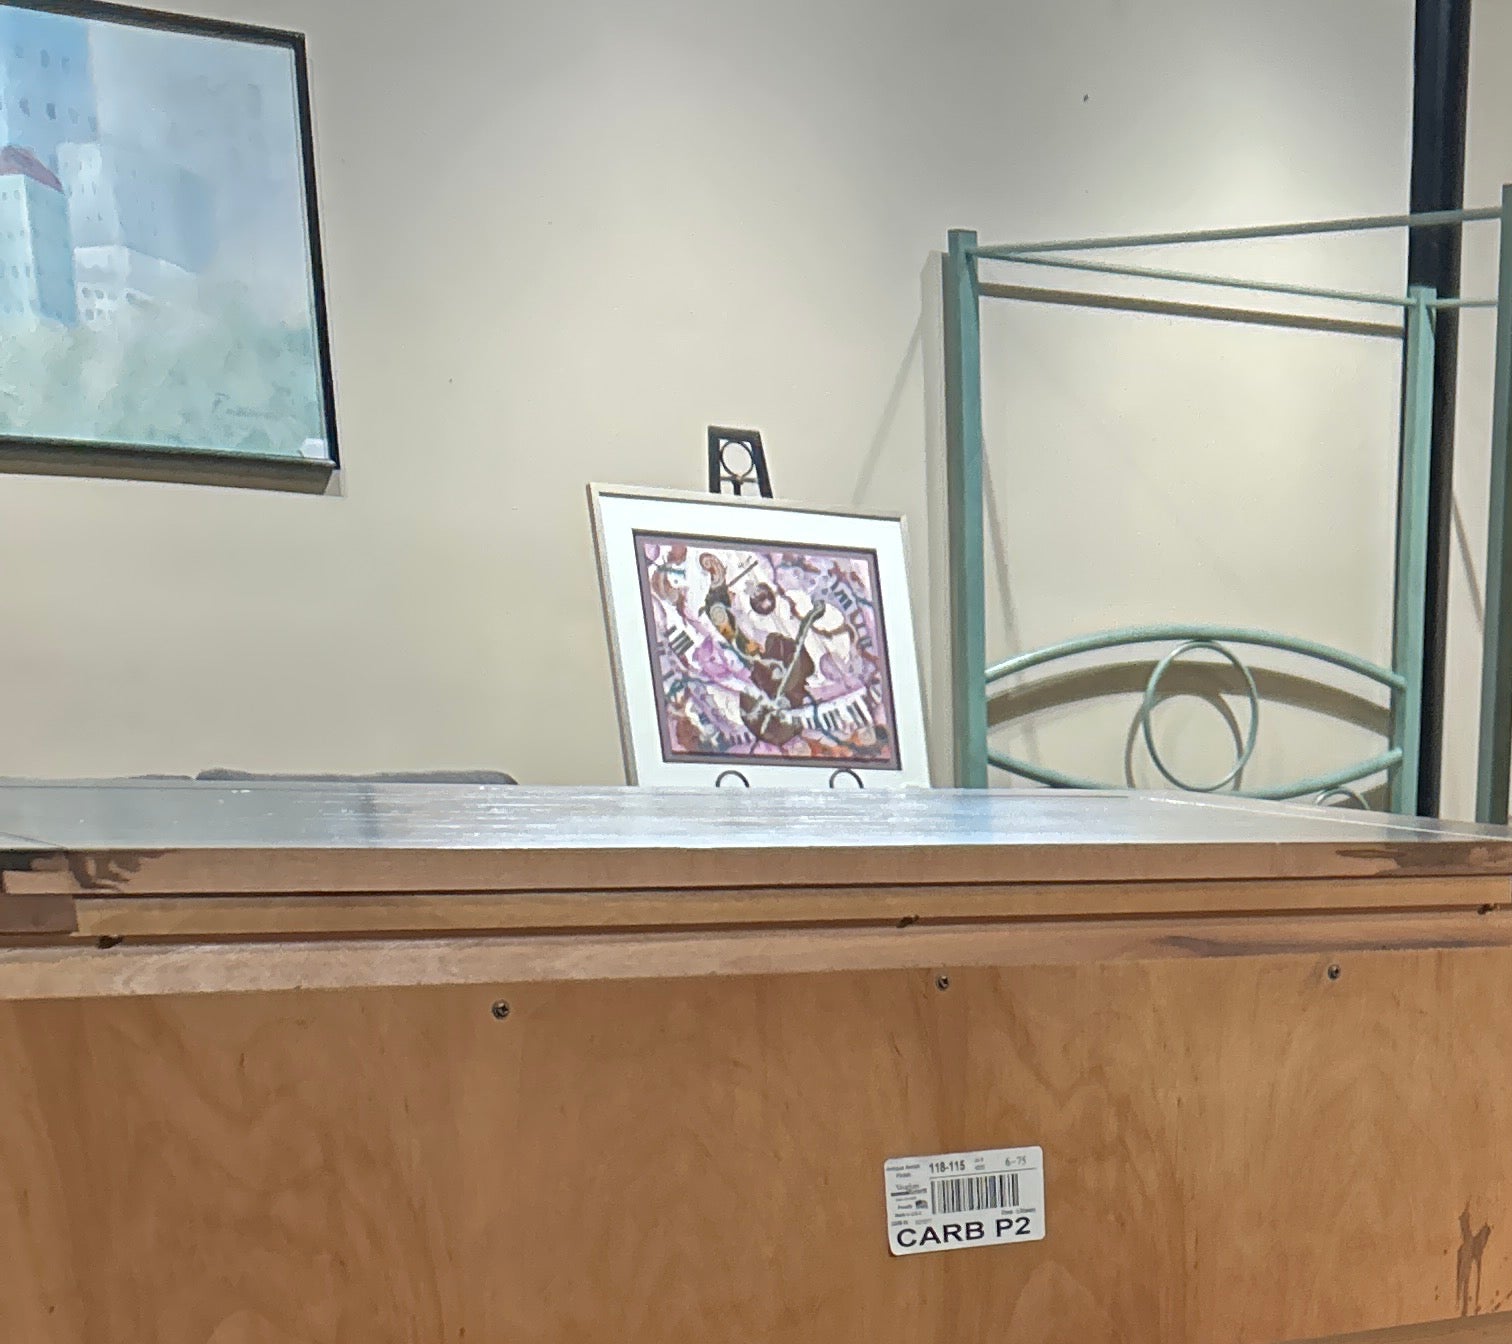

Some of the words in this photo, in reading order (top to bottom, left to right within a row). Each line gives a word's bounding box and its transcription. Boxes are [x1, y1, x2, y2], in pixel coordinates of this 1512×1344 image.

[929, 1160, 966, 1173] 118-115
[897, 1221, 985, 1248] CARB
[996, 1217, 1031, 1238] P2
